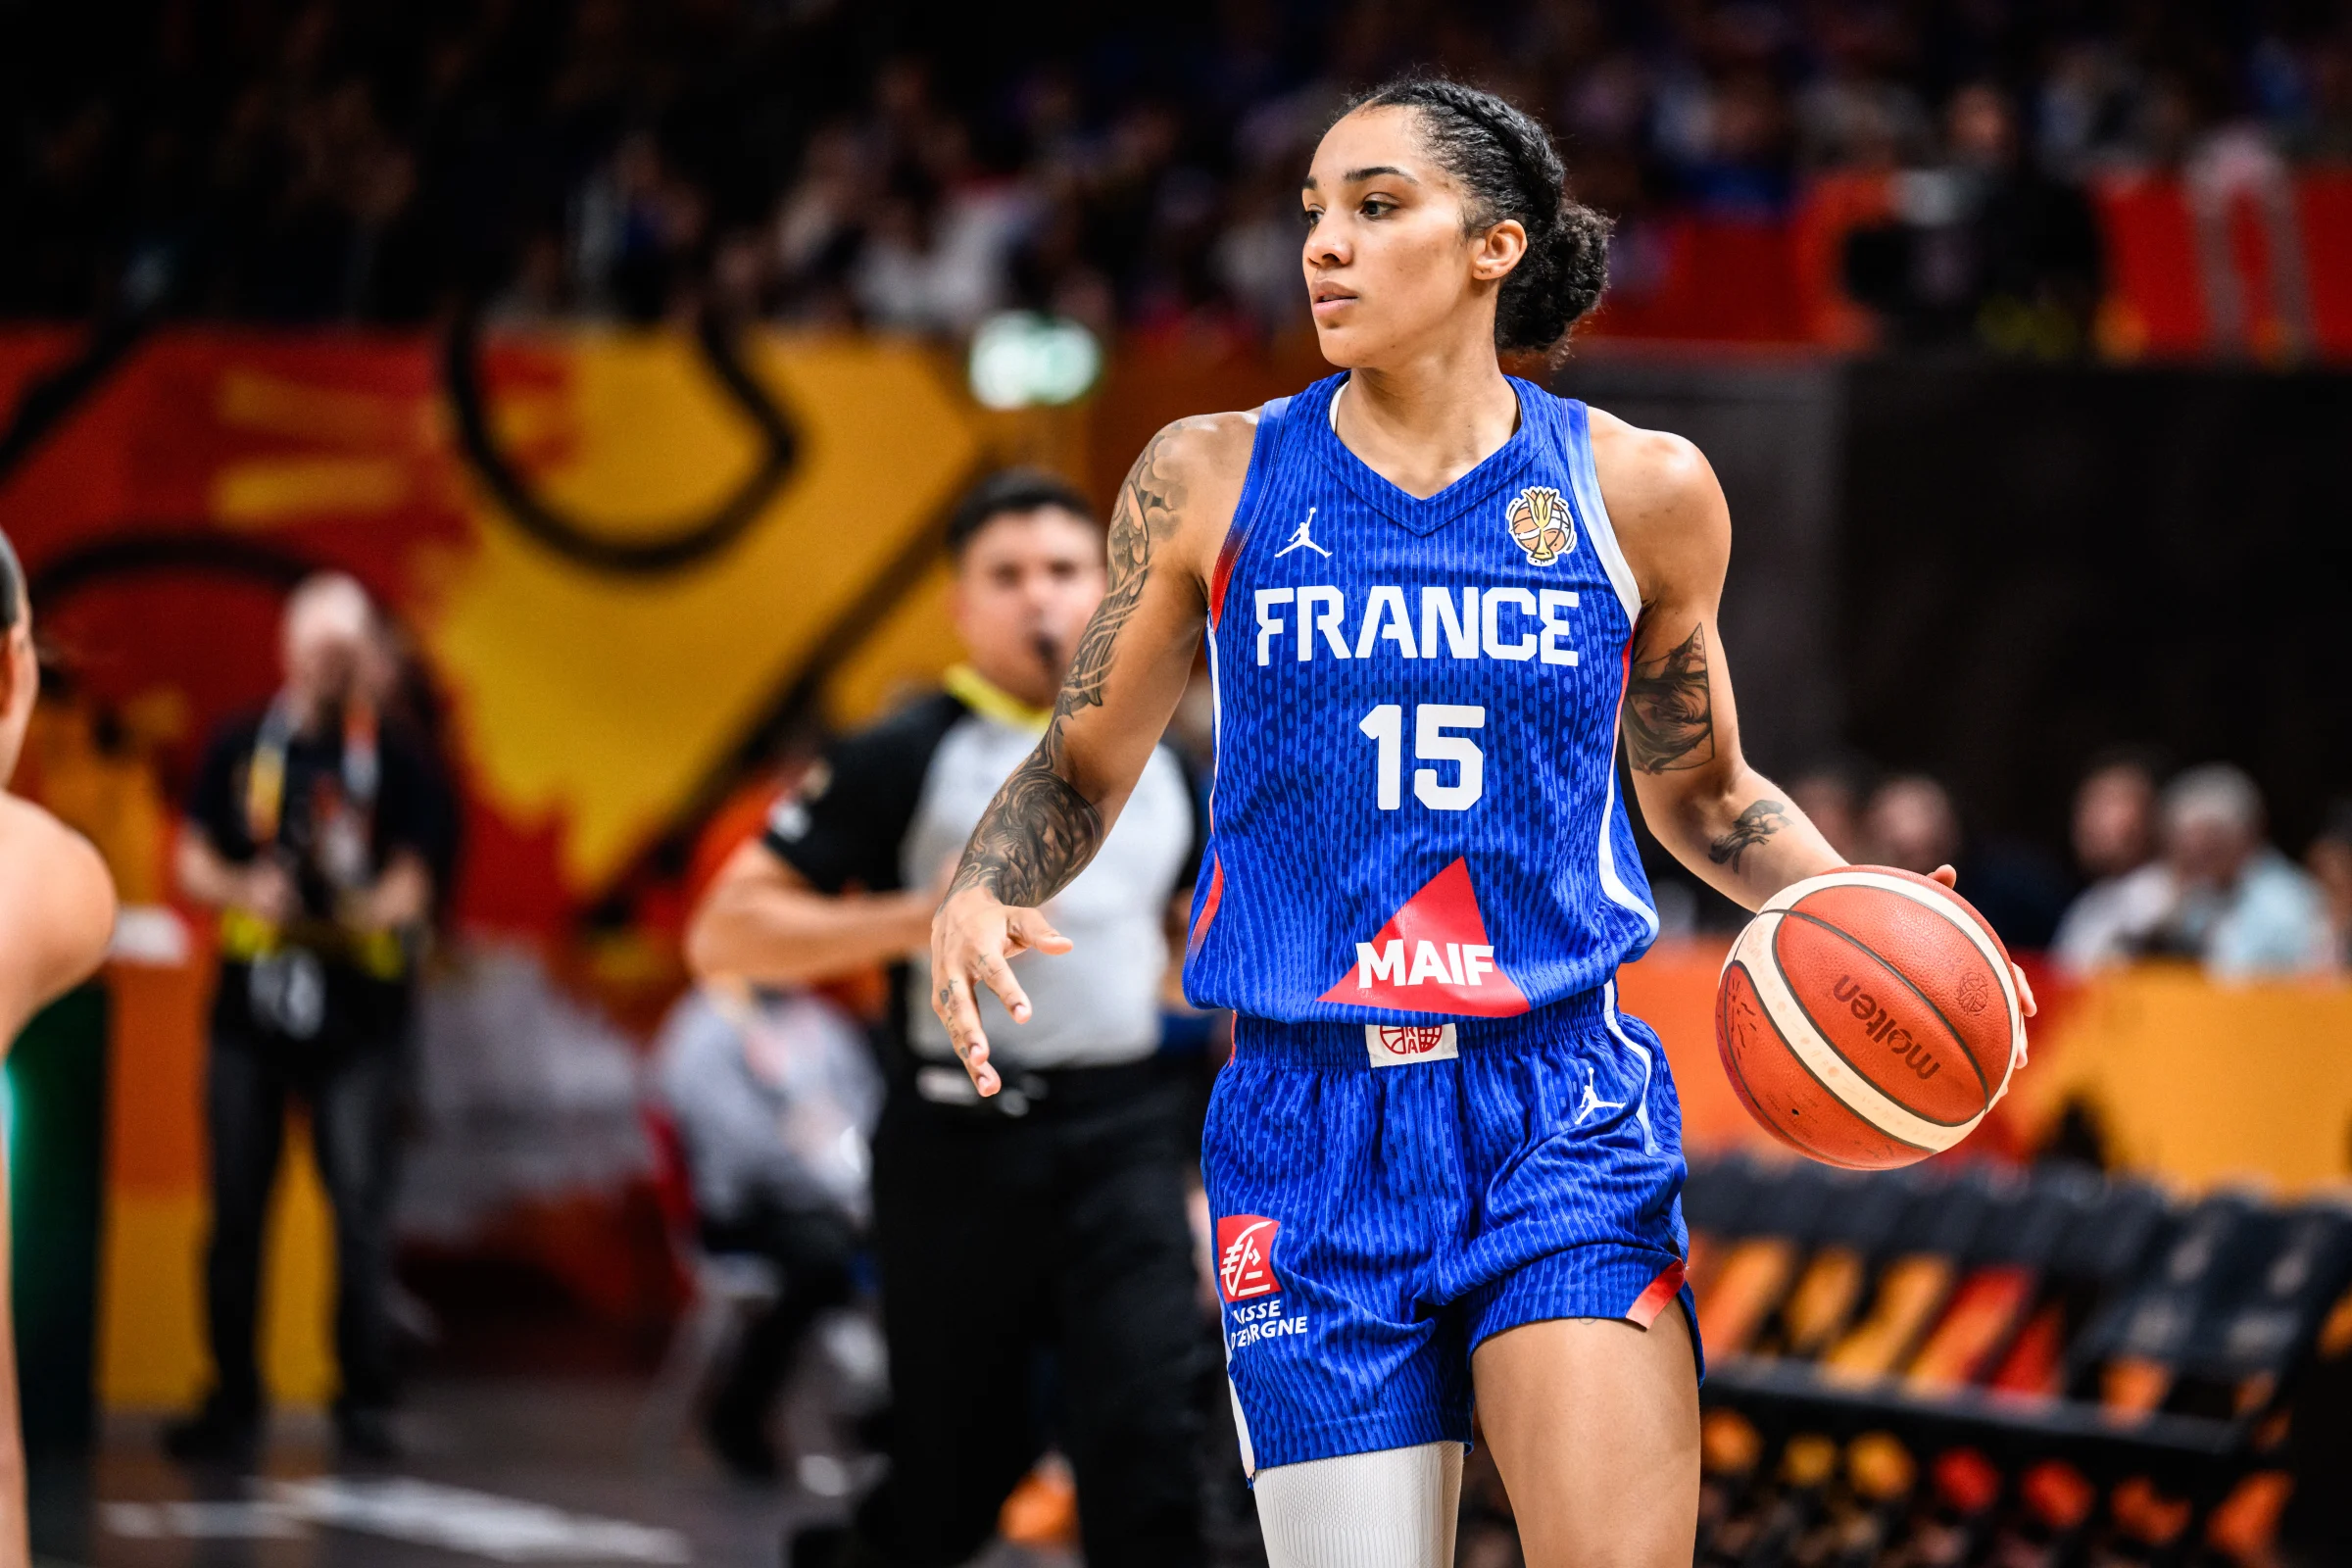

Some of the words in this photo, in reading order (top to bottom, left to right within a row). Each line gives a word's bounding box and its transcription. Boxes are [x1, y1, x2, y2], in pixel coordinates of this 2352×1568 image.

[1254, 585, 1579, 667] FRANCE
[1359, 704, 1486, 811] 15
[1355, 938, 1494, 989] MAIF
[1833, 974, 1941, 1080] molten
